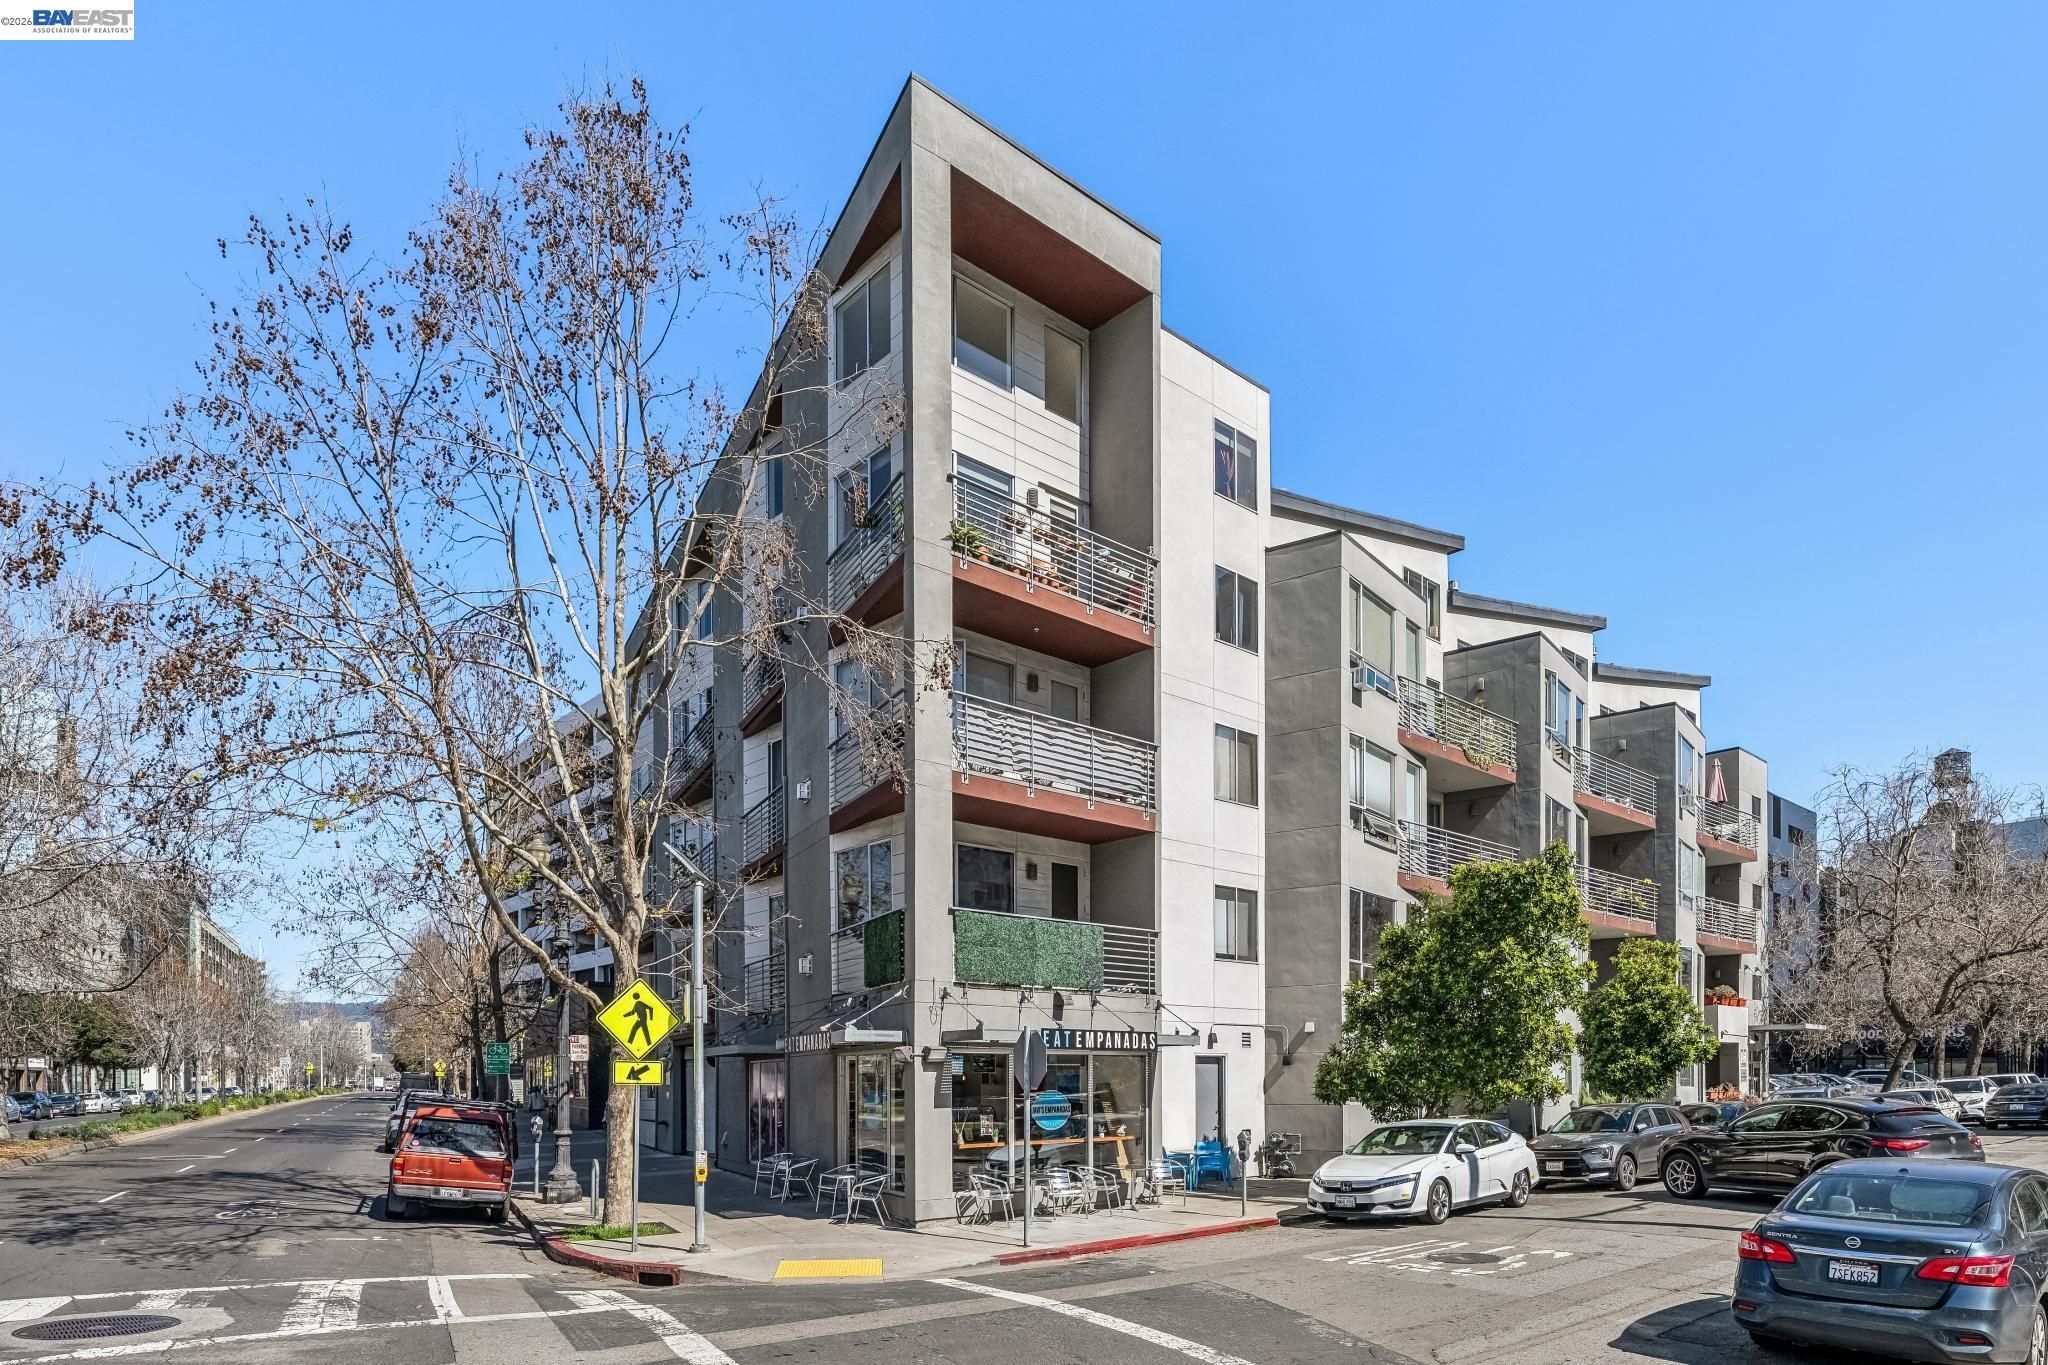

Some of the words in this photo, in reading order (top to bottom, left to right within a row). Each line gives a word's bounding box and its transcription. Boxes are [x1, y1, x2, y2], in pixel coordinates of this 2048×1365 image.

[796, 1032, 830, 1051] EMPANADAS
[1043, 1030, 1071, 1048] EAT
[1075, 1031, 1156, 1050] EMPANADAS
[1766, 1231, 1798, 1239] SENTRA
